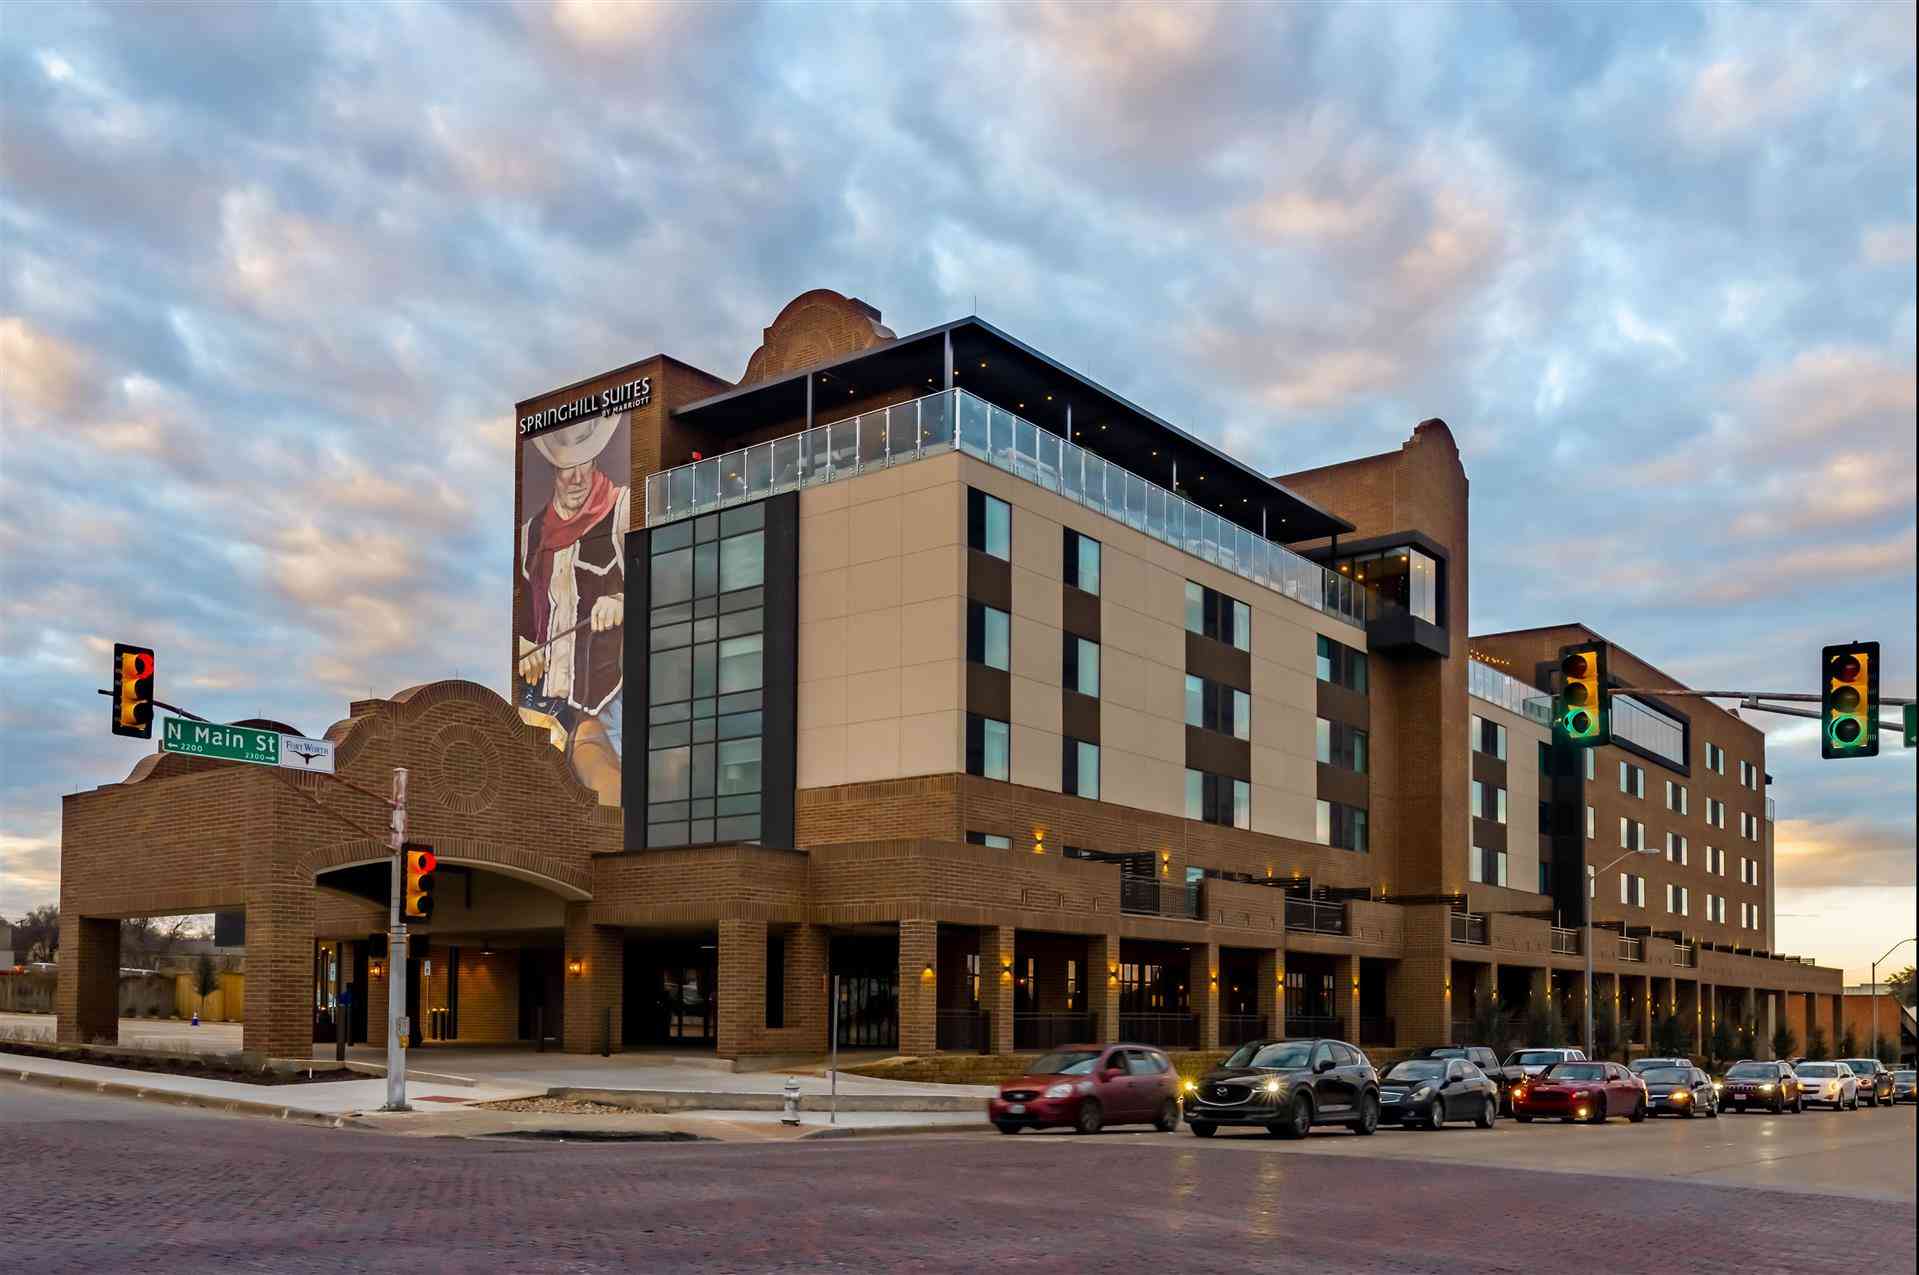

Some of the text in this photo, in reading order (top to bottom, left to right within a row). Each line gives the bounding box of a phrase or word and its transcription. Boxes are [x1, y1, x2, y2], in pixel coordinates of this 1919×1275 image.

[602, 377, 650, 407] SUITES
[612, 396, 649, 416] MARRIOTT
[167, 722, 276, 753] N Main St
[180, 742, 203, 752] 2200
